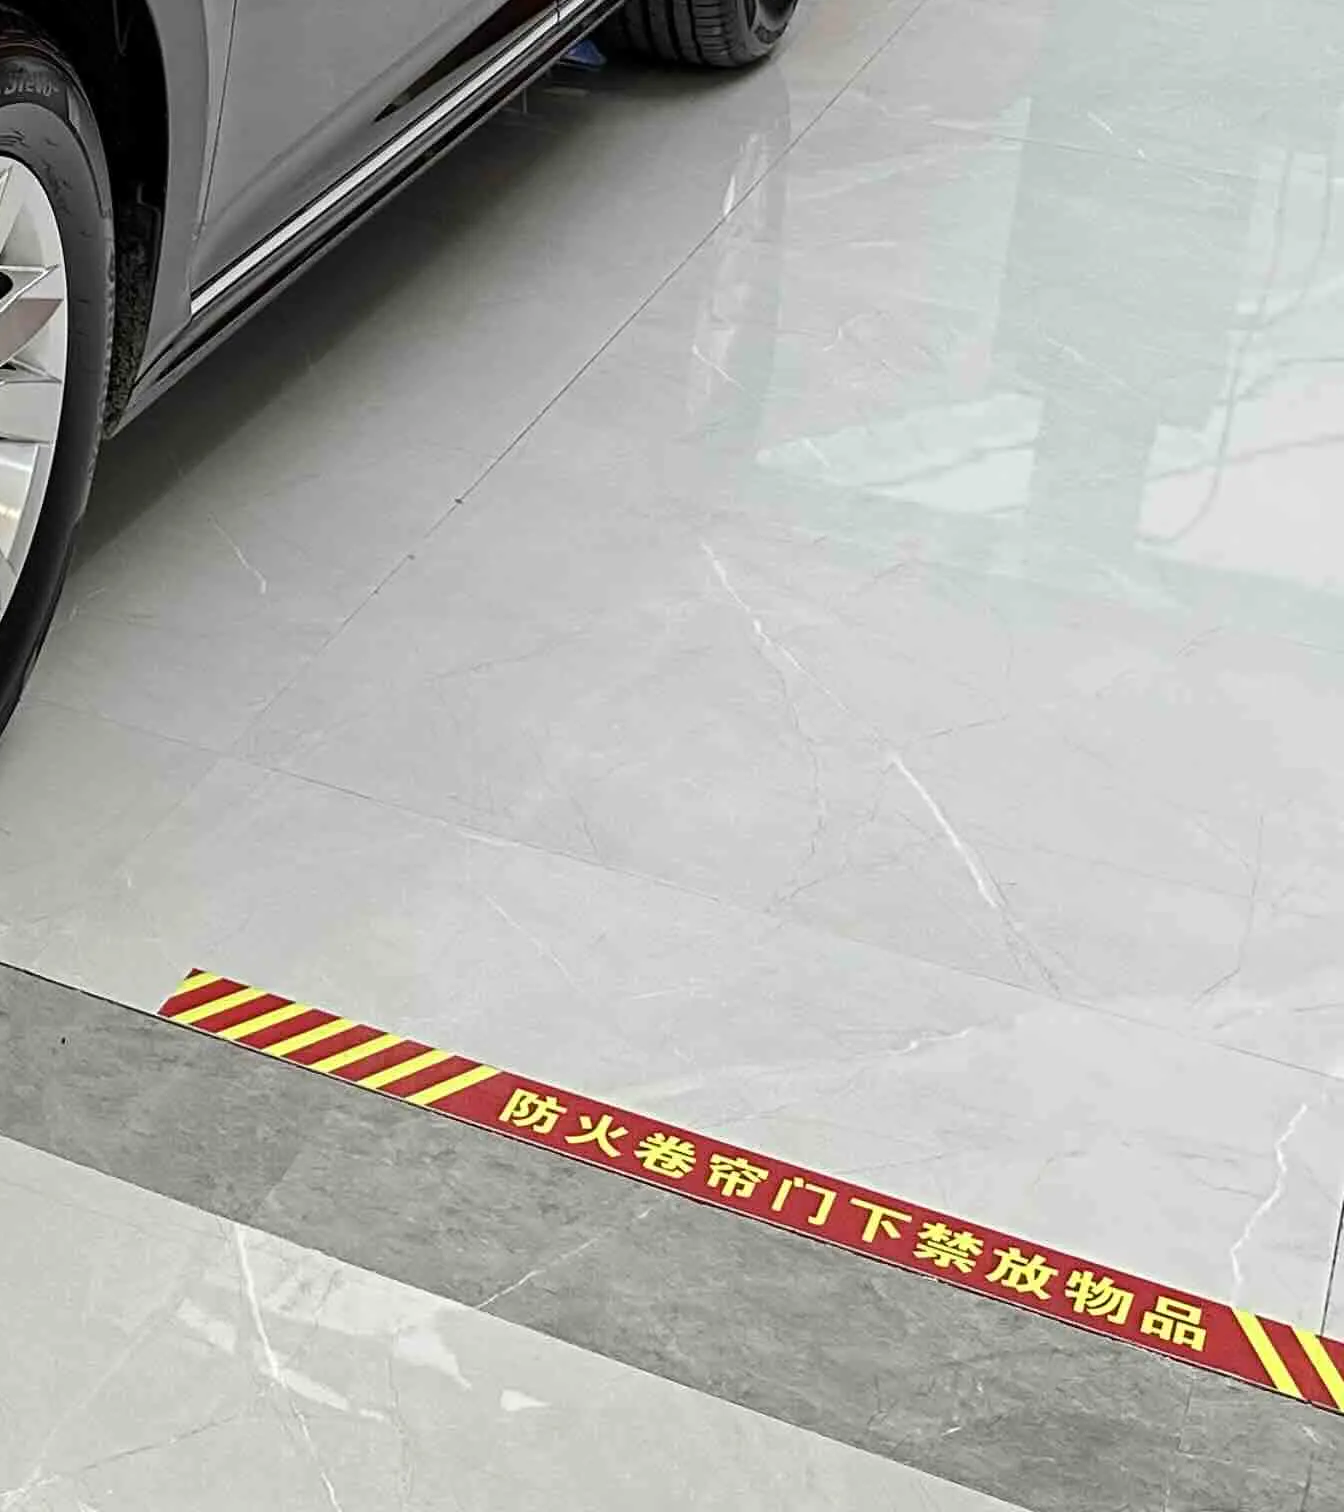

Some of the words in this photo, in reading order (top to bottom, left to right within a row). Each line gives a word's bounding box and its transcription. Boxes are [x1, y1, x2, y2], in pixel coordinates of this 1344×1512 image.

[498, 1087, 1208, 1352] 防火卷帘门下禁放物品
